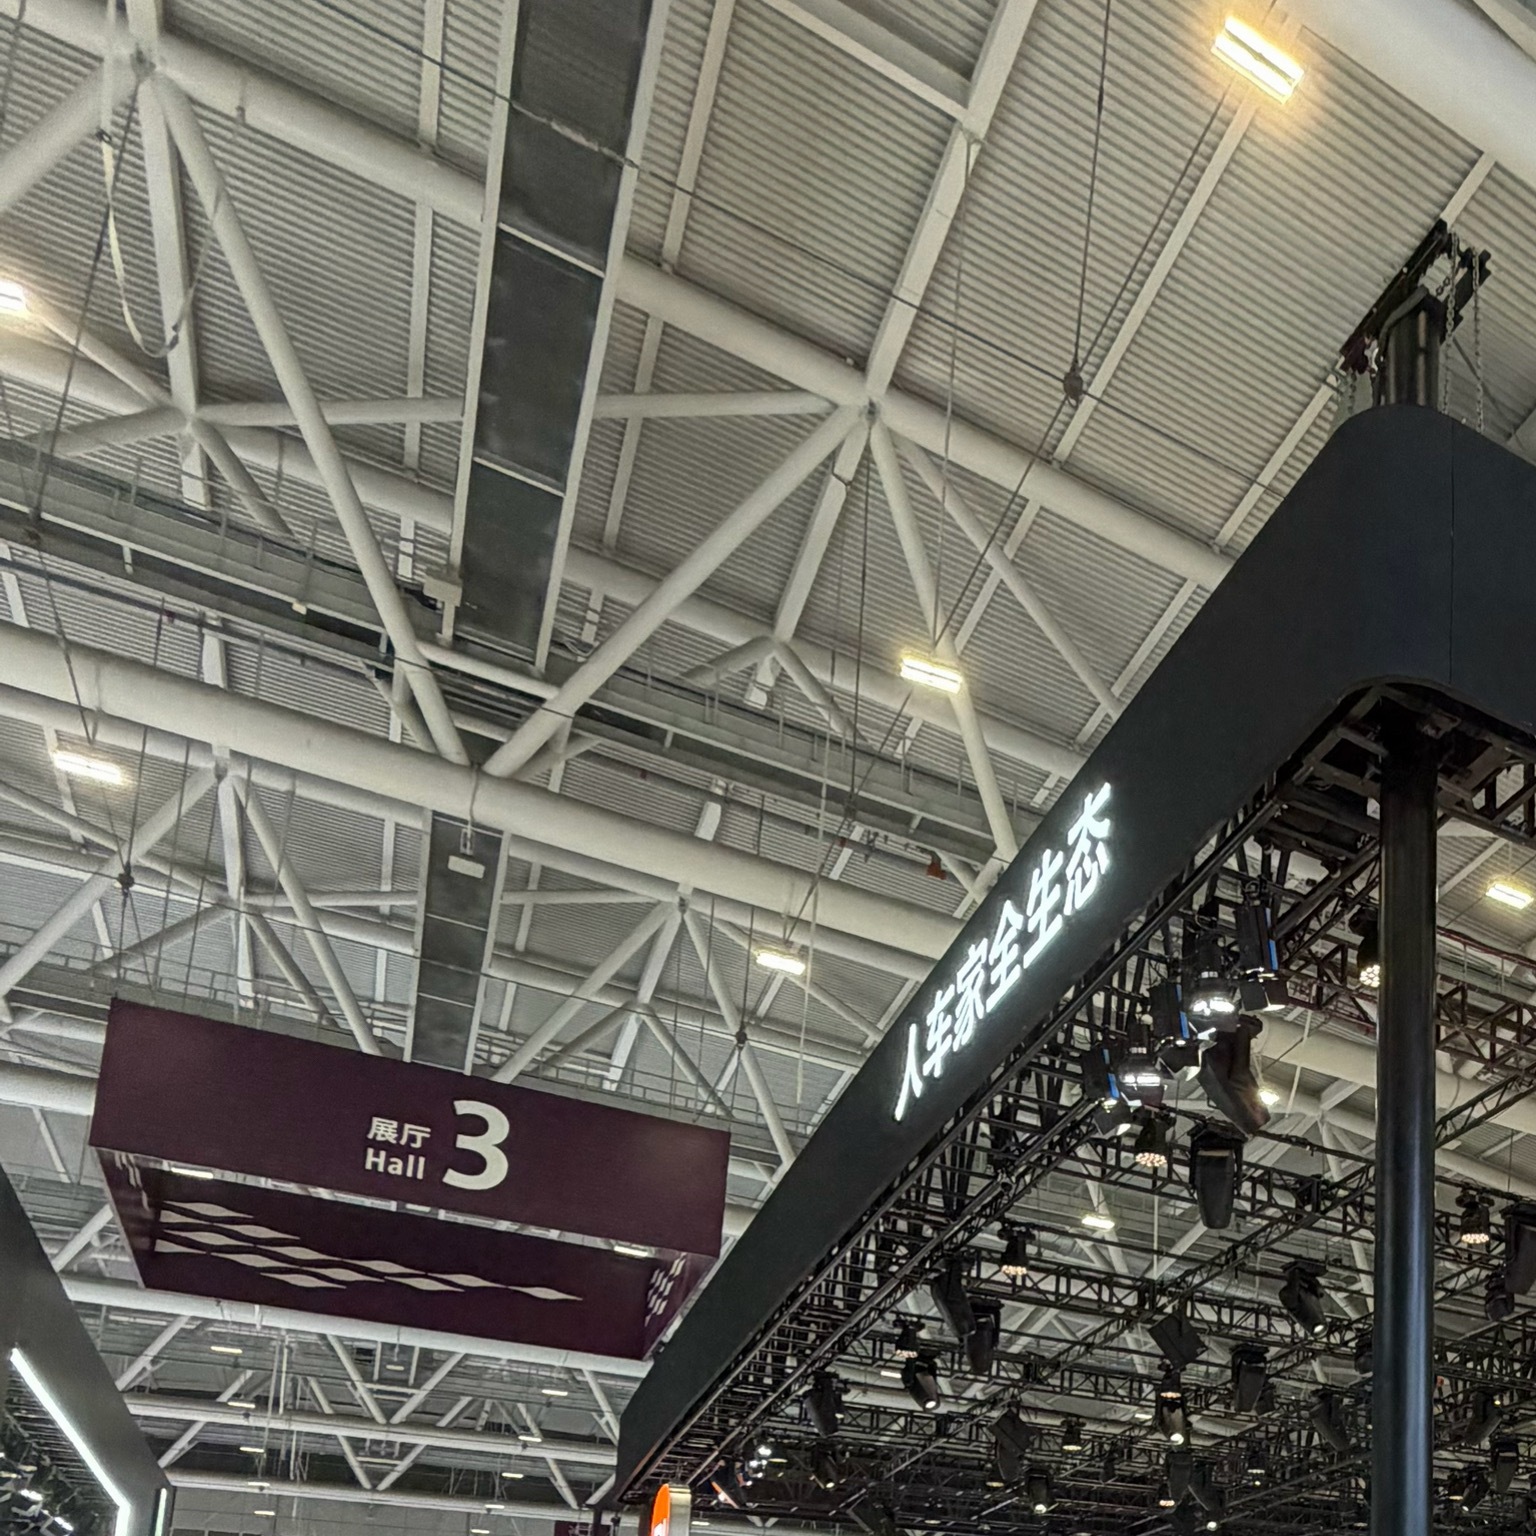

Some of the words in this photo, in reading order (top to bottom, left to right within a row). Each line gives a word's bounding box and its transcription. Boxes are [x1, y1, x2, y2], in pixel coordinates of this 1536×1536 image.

[894, 781, 1111, 1121] 人车家全生态
[364, 1147, 426, 1180] Hall
[366, 1116, 432, 1149] 展厅
[442, 1099, 510, 1191] 3
